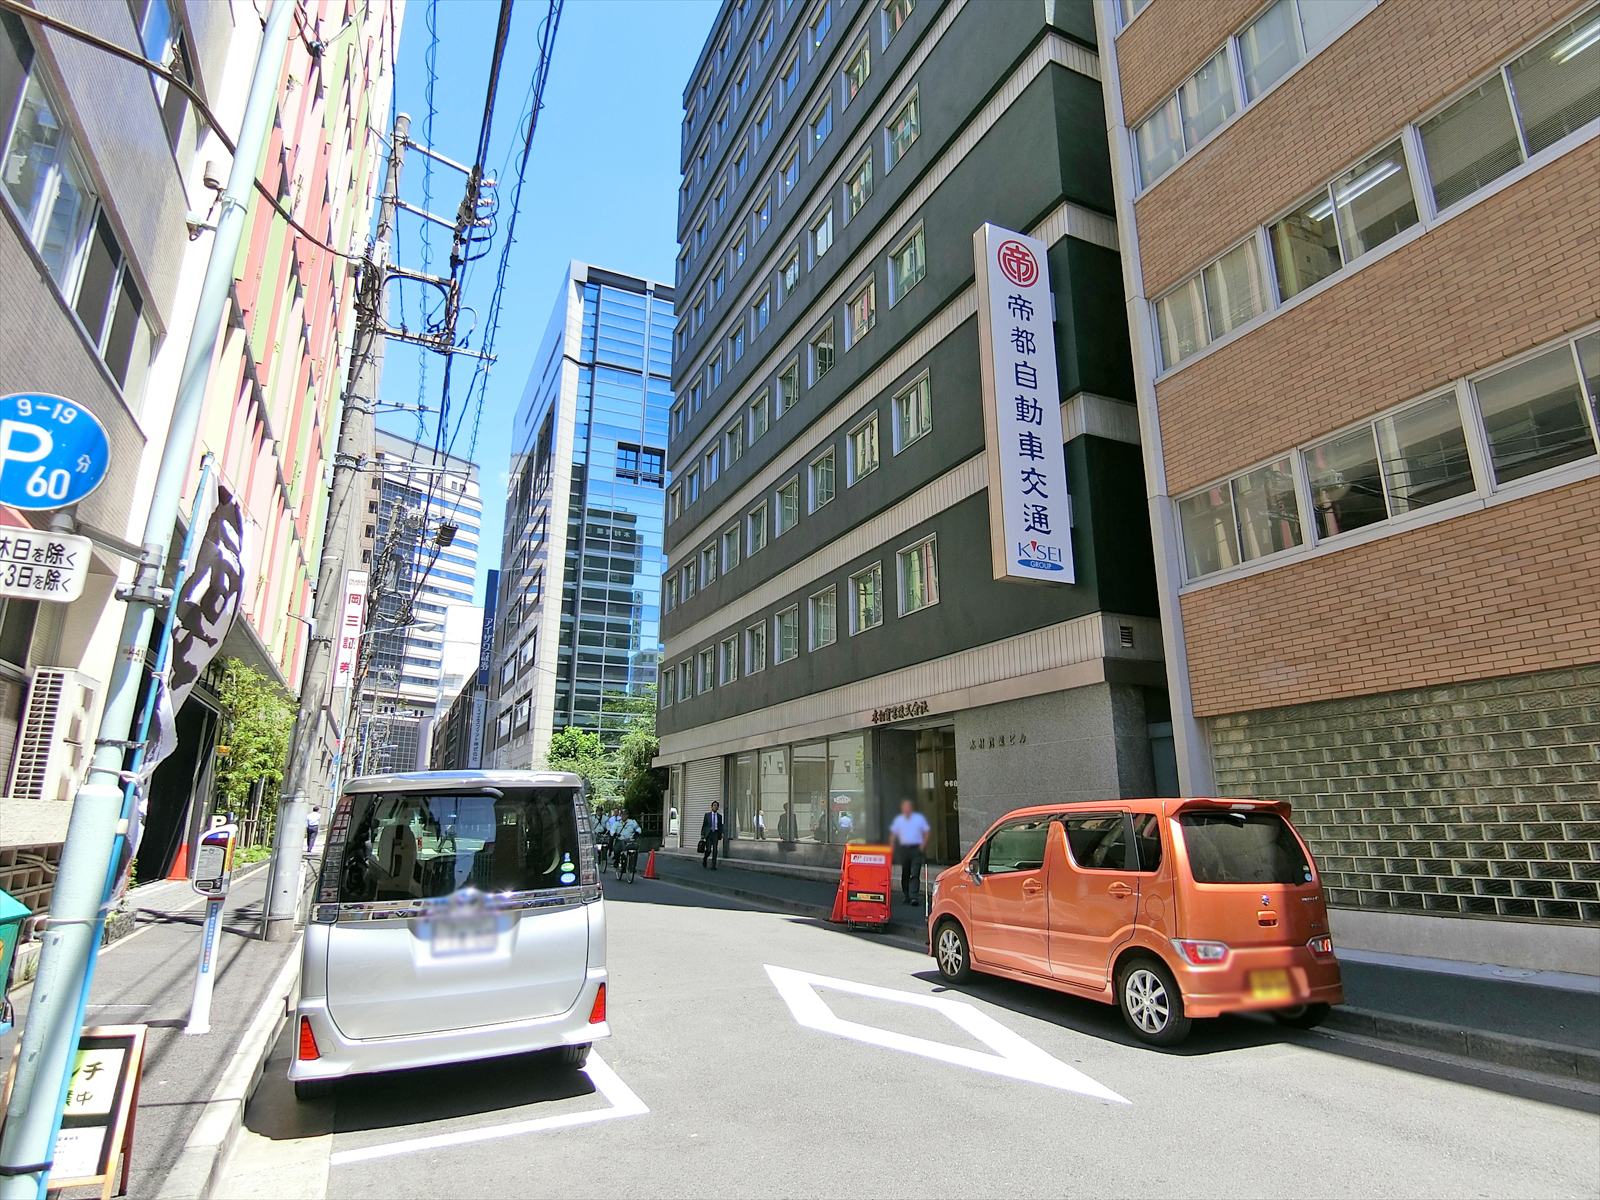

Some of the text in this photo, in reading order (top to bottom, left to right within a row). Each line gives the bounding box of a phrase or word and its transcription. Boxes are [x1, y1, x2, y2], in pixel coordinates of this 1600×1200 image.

[17, 398, 78, 425] 9-19
[1007, 293, 1053, 535] 帝都自動車交通
[1030, 560, 1052, 570] GROUP
[480, 617, 493, 671] アイザワ証券
